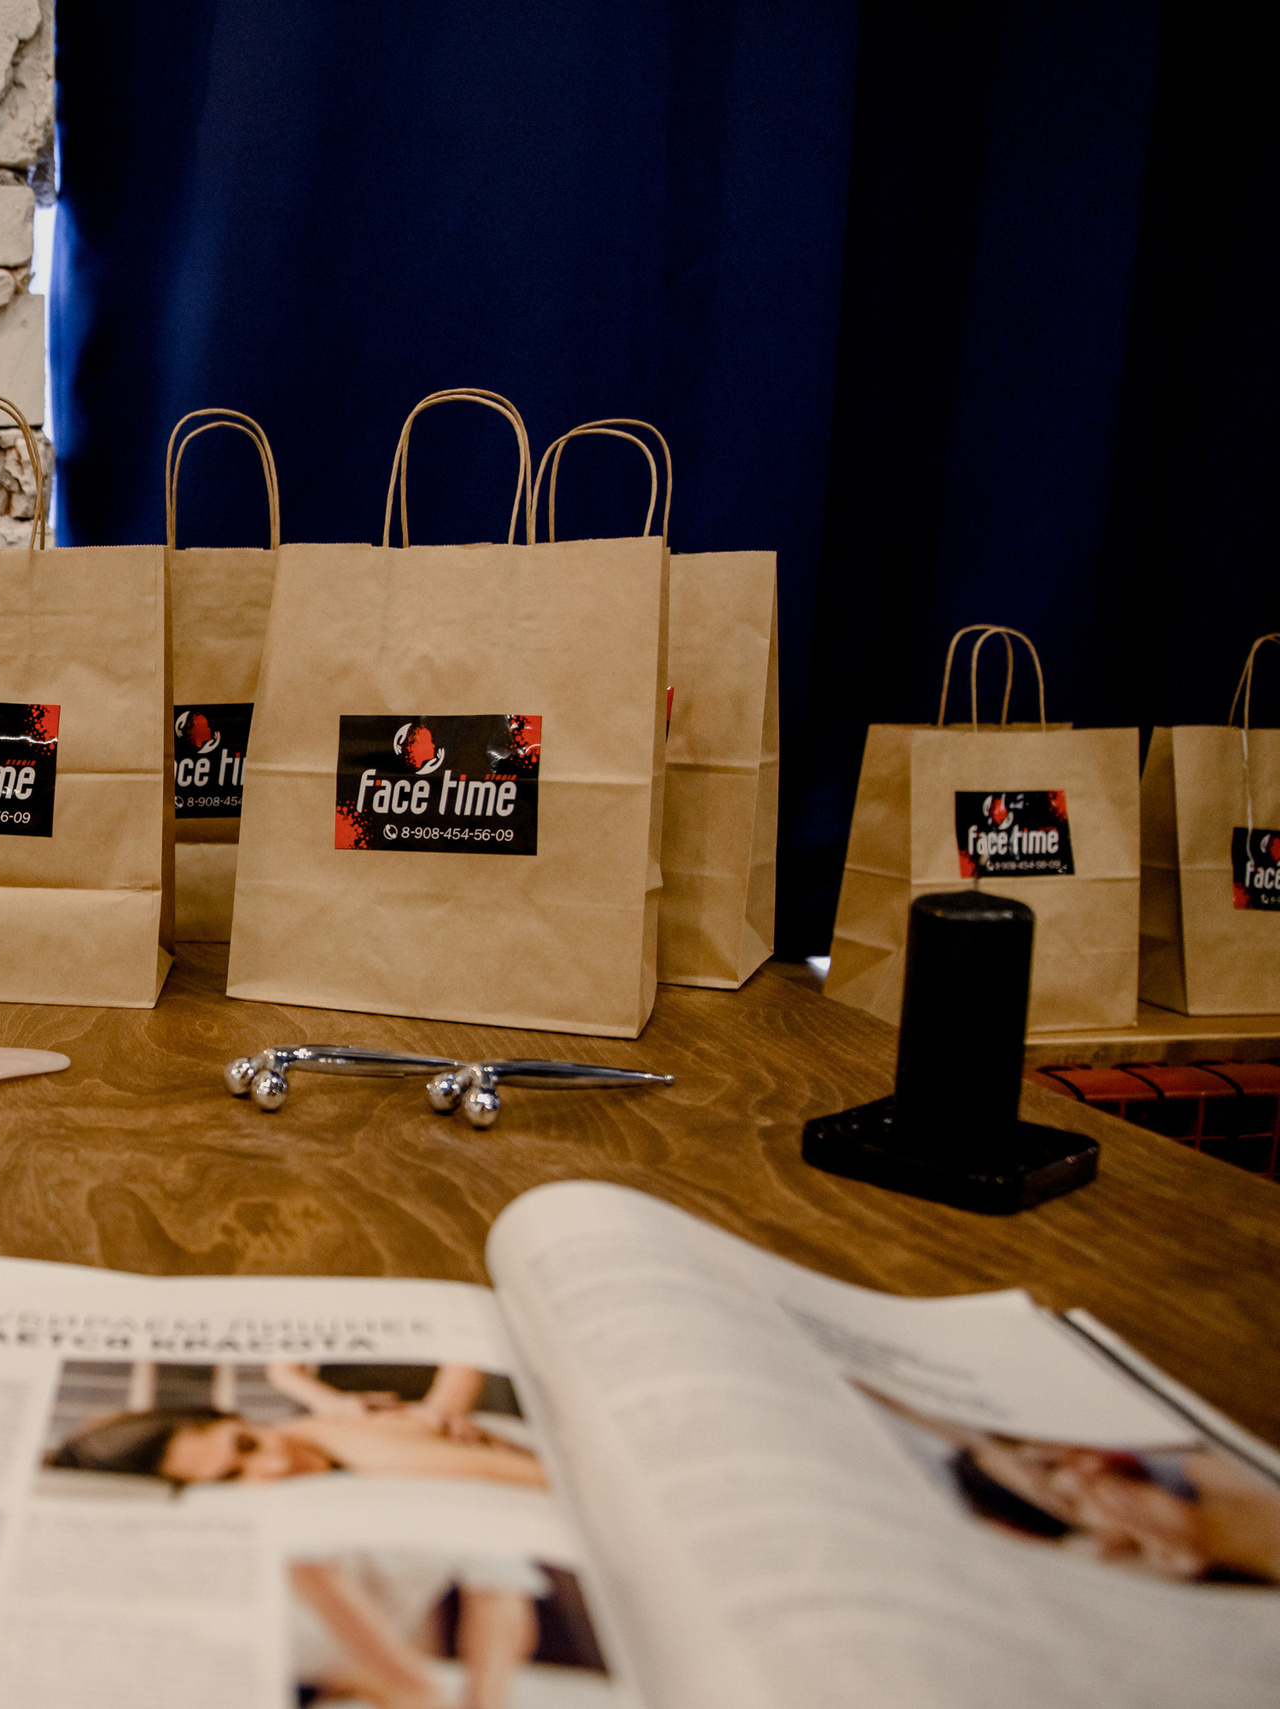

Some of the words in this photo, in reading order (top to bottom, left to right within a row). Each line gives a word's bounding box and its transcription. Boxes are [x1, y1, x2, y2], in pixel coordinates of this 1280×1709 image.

[174, 757, 211, 788] ce
[356, 768, 431, 815] face
[438, 769, 518, 817] time
[401, 826, 515, 842] 8-908-454-56-09
[967, 824, 1009, 855] face
[1012, 823, 1060, 855] time
